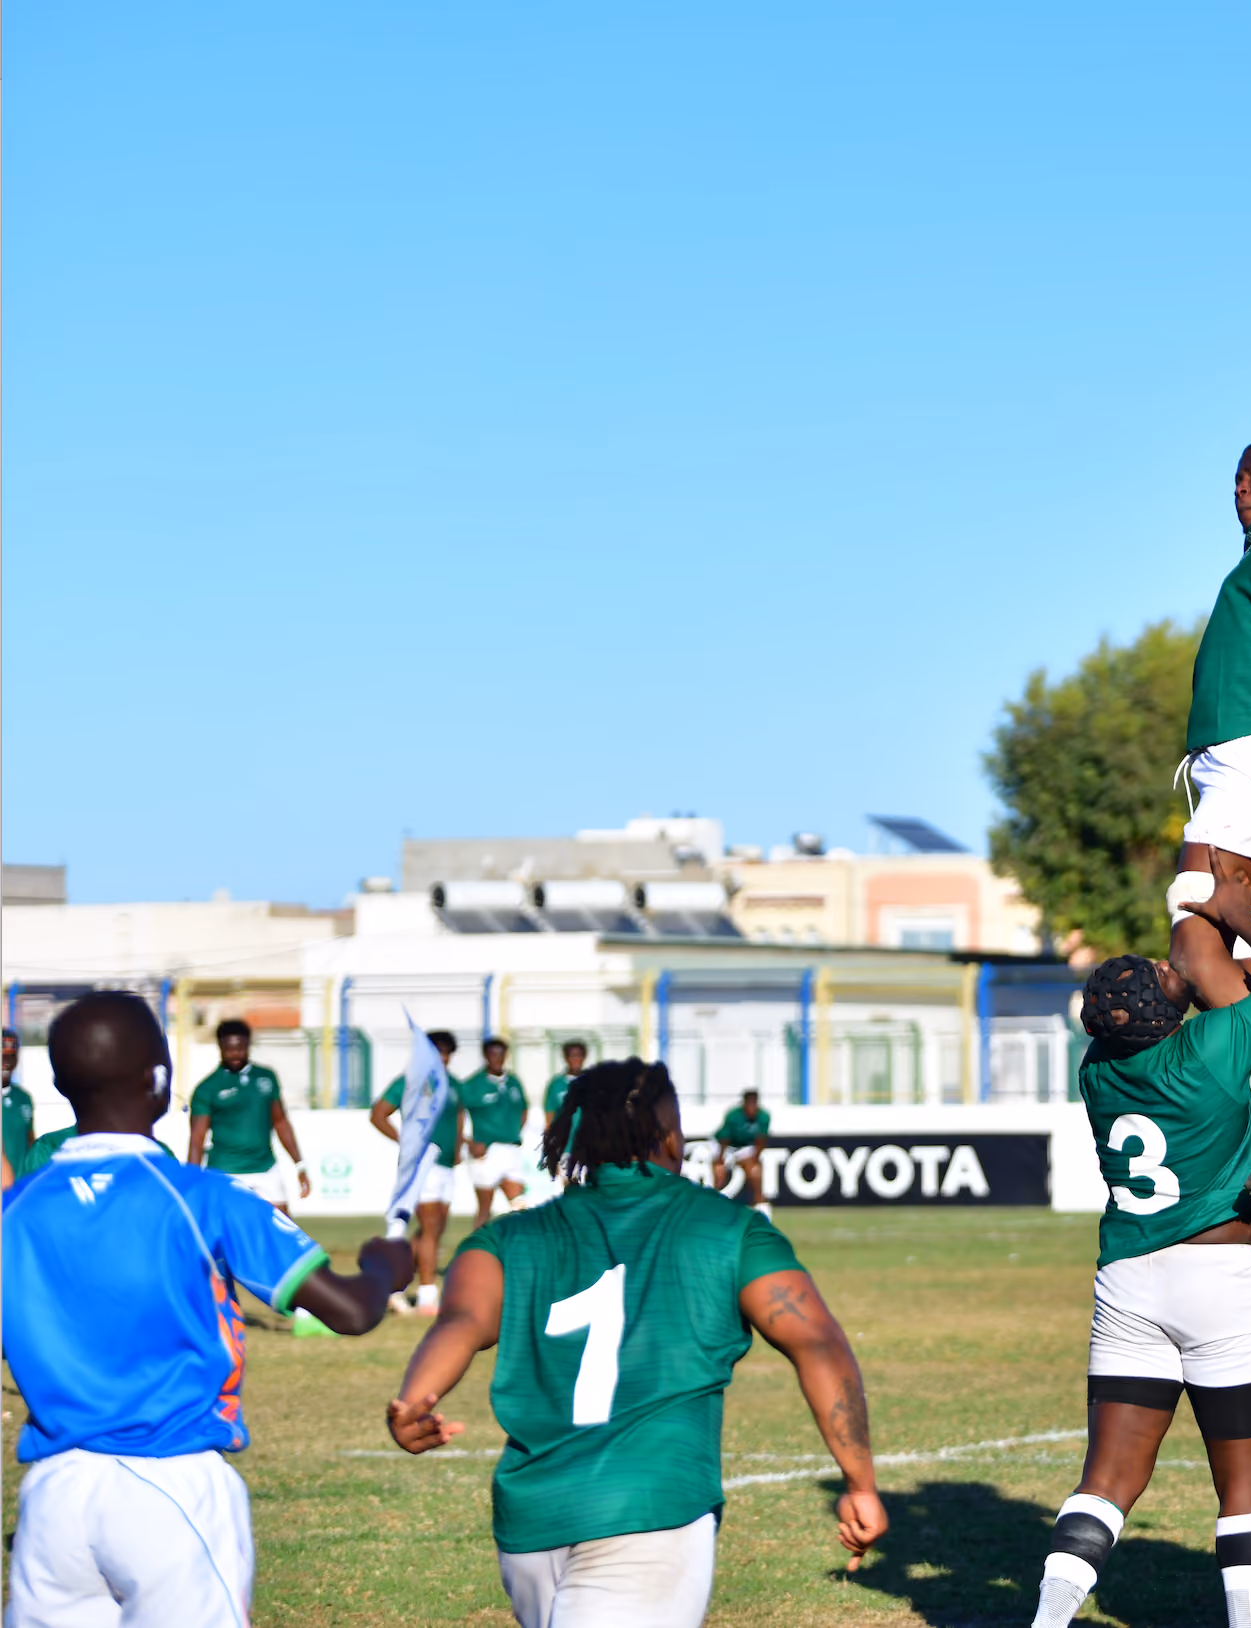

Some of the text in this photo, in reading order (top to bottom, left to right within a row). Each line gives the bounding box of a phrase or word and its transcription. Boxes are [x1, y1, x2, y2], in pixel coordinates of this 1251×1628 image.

[760, 1145, 990, 1199] TOYOTA
[1107, 1114, 1180, 1215] 3
[545, 1264, 625, 1425] 1
